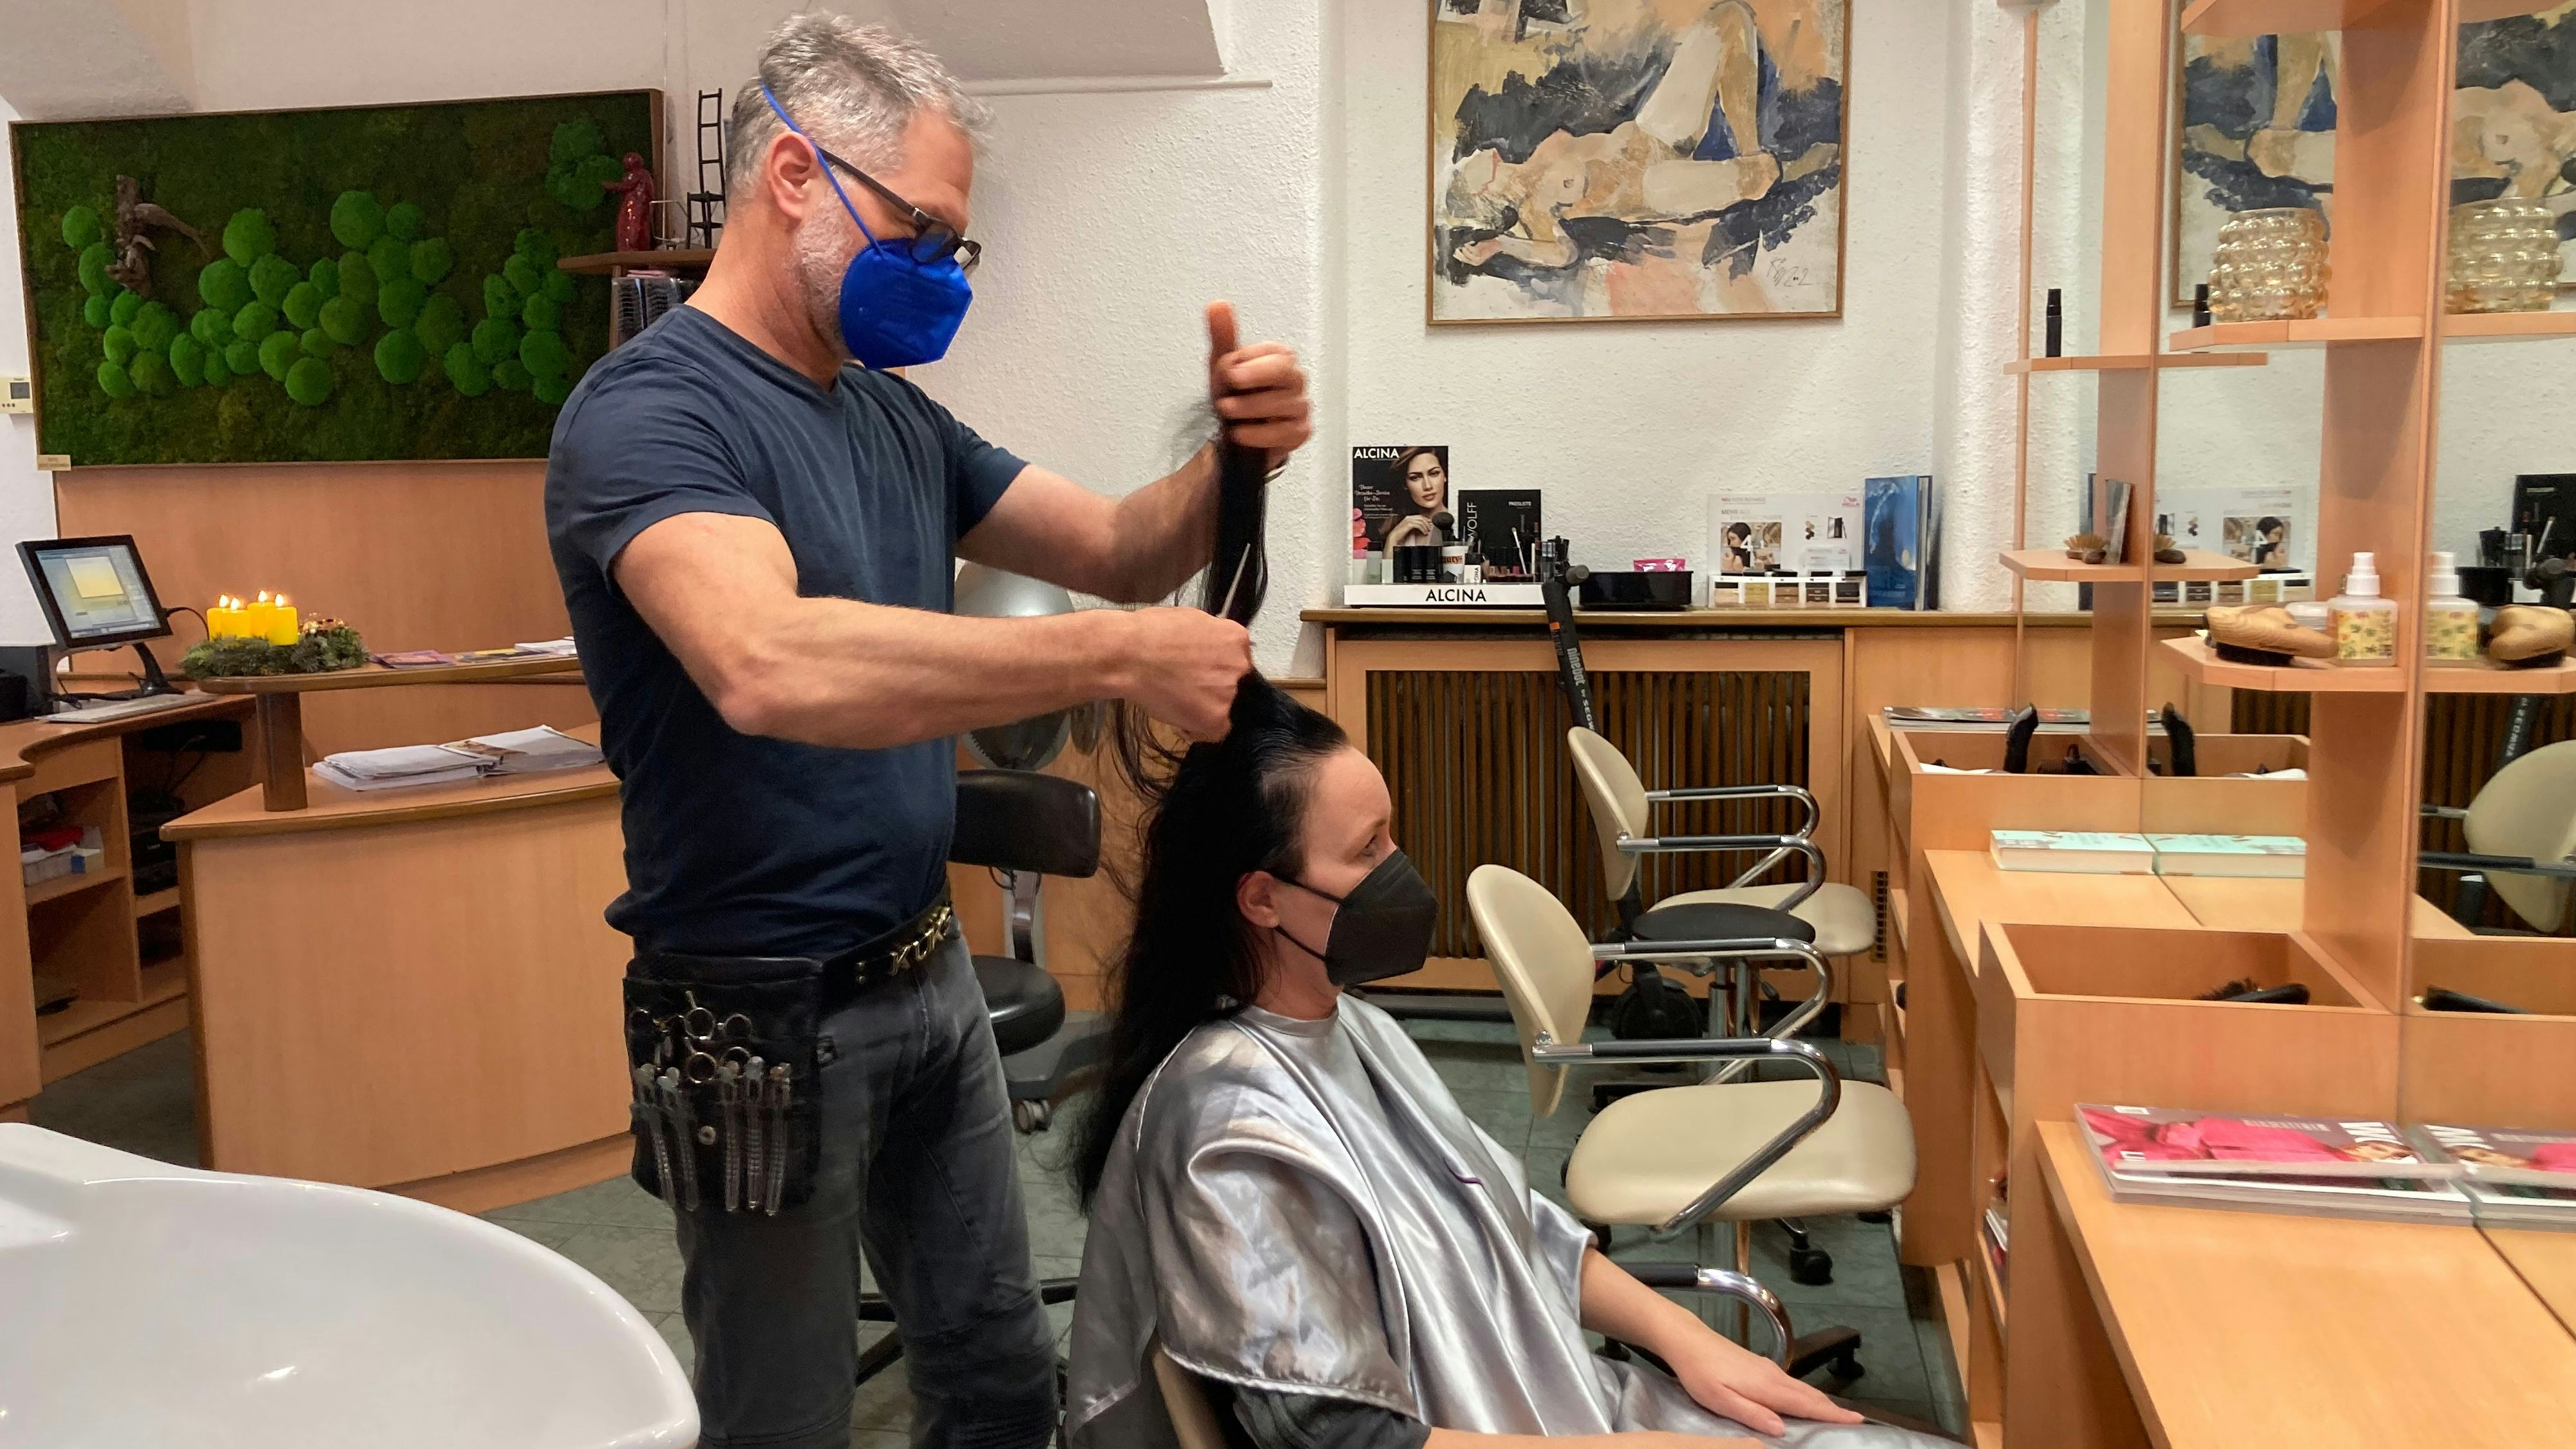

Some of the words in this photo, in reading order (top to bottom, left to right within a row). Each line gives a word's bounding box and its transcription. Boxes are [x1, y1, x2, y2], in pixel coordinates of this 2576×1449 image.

[1354, 448, 1399, 459] ALCINA
[1425, 589, 1486, 601] ALCINA
[1567, 648, 1586, 686] ninebot
[1583, 699, 1595, 731] SEGW
